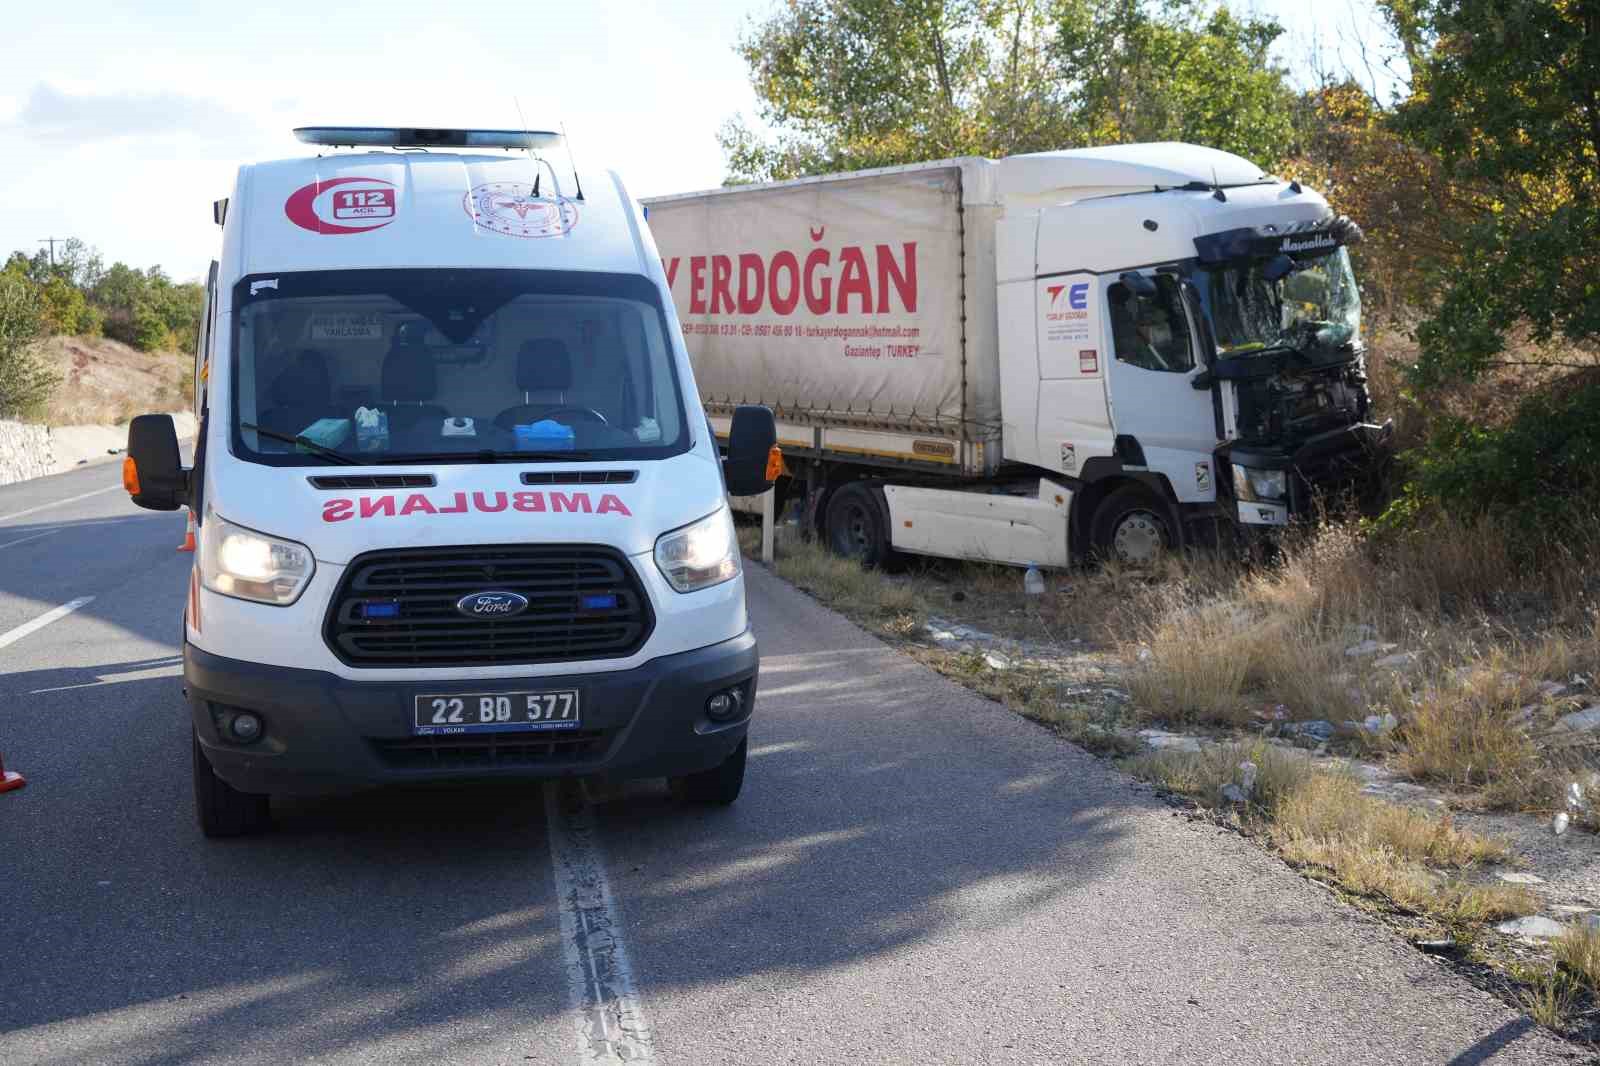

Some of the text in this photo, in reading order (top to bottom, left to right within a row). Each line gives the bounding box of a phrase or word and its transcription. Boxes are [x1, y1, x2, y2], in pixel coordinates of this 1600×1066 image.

[342, 191, 385, 206] 112
[688, 225, 918, 315] ERDOĞAN
[887, 343, 919, 358] TURKEY
[474, 597, 512, 612] Ford
[432, 693, 573, 723] 22 BD 577
